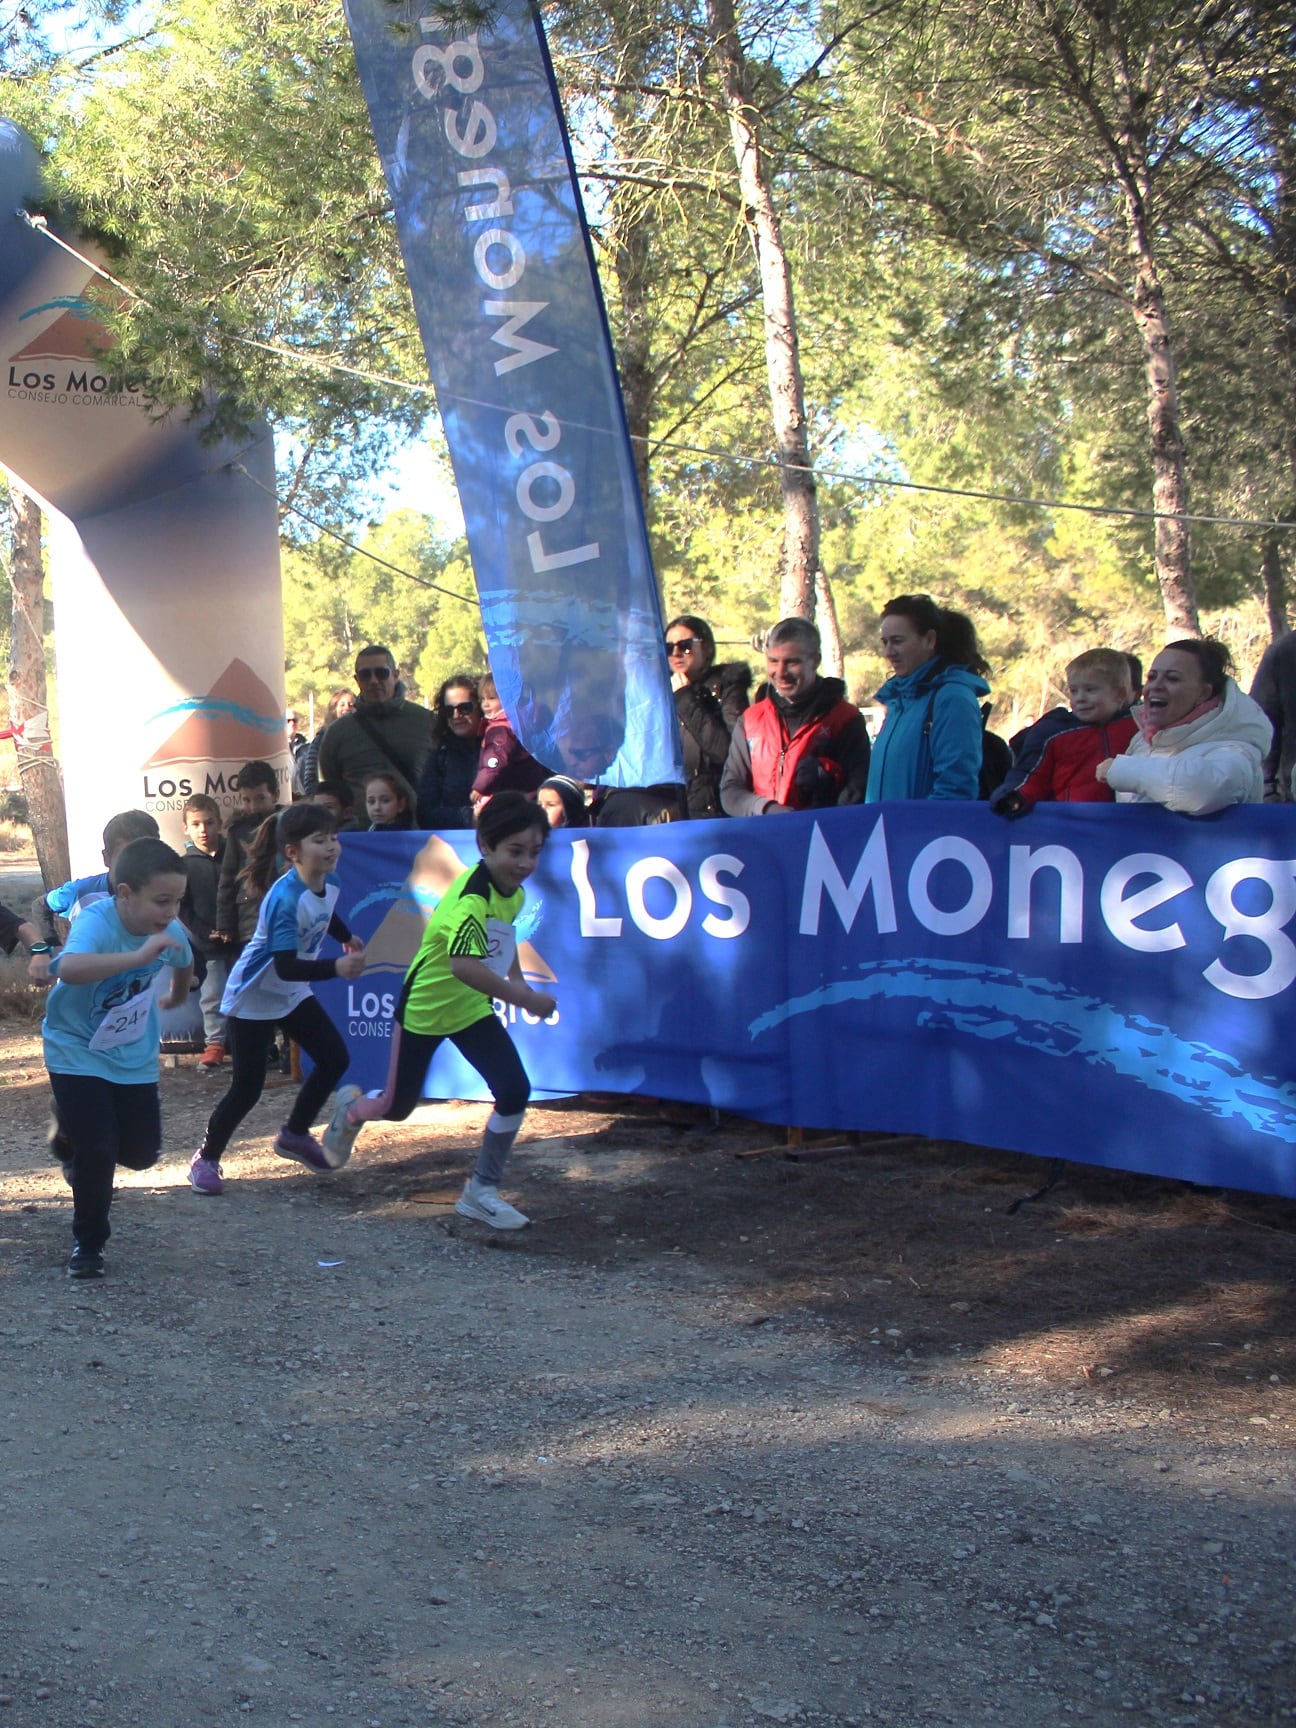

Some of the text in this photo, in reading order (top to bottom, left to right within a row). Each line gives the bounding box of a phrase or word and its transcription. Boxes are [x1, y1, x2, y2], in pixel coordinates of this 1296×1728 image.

[8, 366, 55, 391] Los
[7, 388, 145, 407] CONSEJO COMARCAL
[143, 775, 193, 798] Los
[570, 813, 1296, 999] Los Moneg
[348, 985, 396, 1018] Los
[114, 1009, 139, 1034] 24
[348, 1020, 391, 1038] CONSE
